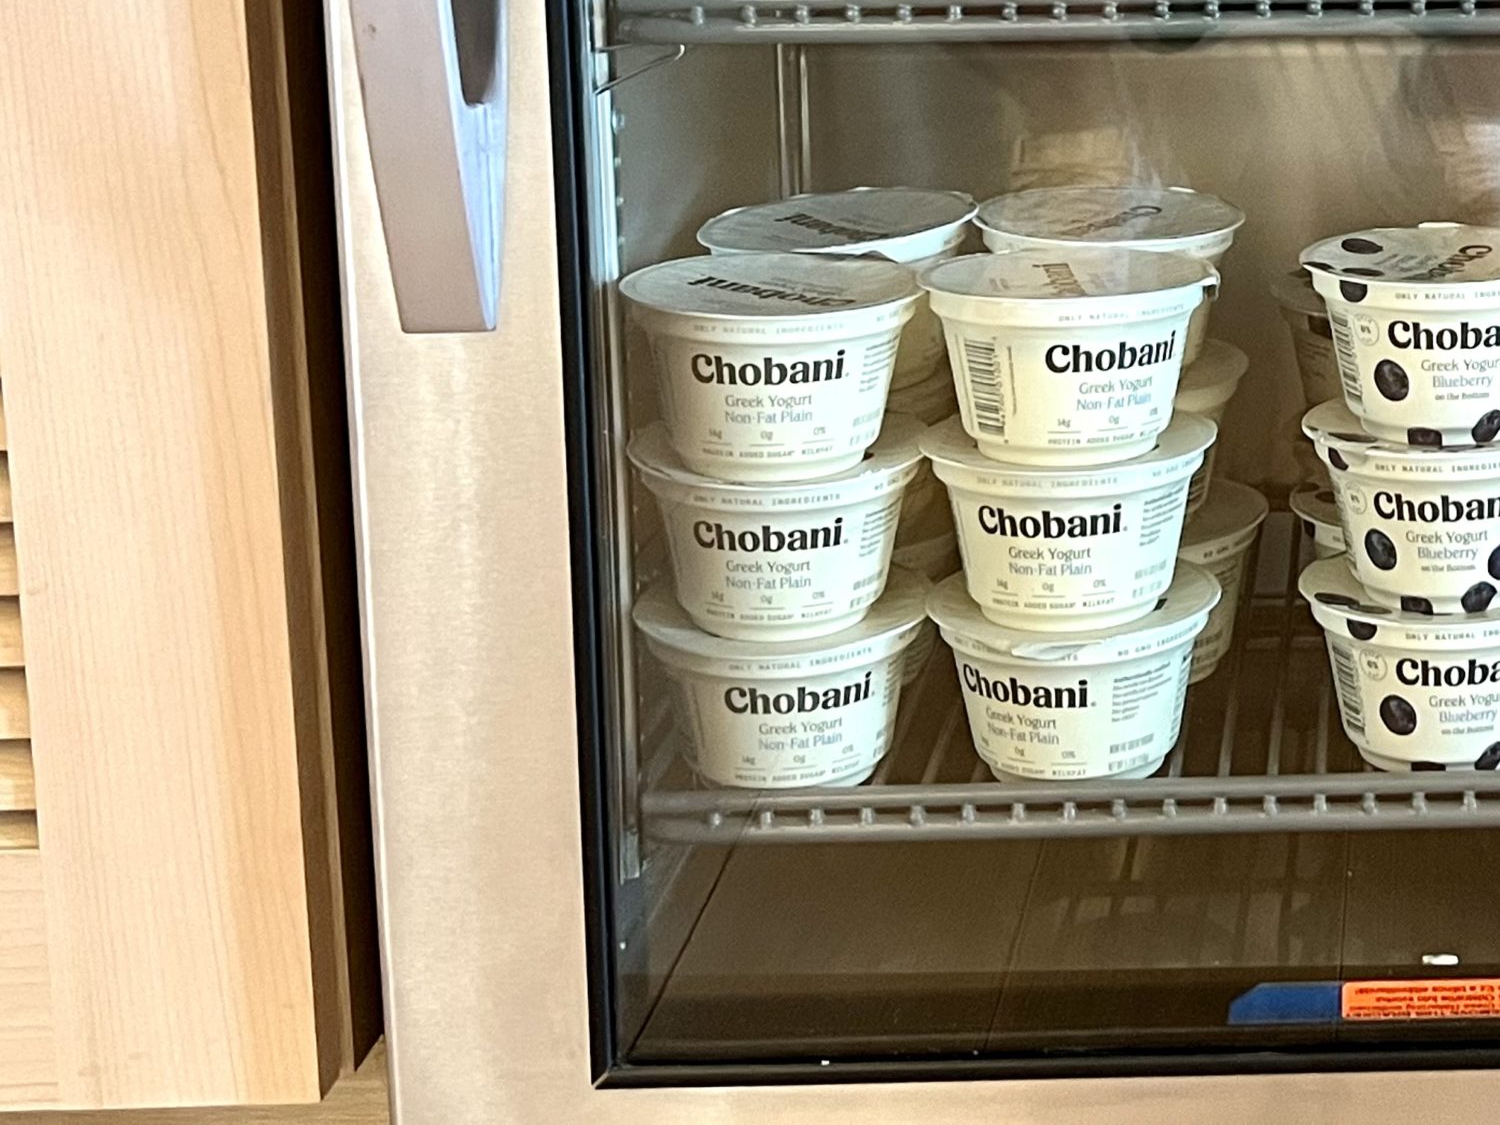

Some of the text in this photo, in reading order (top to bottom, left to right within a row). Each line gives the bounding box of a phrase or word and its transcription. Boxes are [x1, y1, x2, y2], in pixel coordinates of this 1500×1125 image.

[1045, 330, 1176, 373] Chobani
[692, 349, 845, 386] Chobani
[1421, 360, 1459, 371] Greek
[1079, 377, 1153, 393] Greek Yogurt
[1432, 375, 1493, 388] Blueberry
[726, 395, 812, 408] Greek Yogurt
[1077, 393, 1151, 411] Non-Fat Plain
[726, 411, 812, 423] Non-Fat Plain
[978, 504, 1122, 539] Chobani
[693, 517, 843, 552] Chobani
[1406, 530, 1488, 543] Greek Yogurt
[1009, 547, 1091, 563] Greek Yogurt
[1418, 547, 1478, 560] Blueberry
[727, 560, 810, 574] Greek Yogurt
[1009, 563, 1092, 575] Non-Fat Plain
[727, 576, 811, 589] Non-Fat Plain
[725, 672, 872, 714] Chobani
[963, 663, 1088, 709] Chobani
[1429, 695, 1466, 707] Greek
[986, 707, 1056, 730] Greek Yogurt
[1439, 709, 1498, 724] Blueberry
[759, 717, 842, 735] Greek Yogurt
[759, 732, 842, 750] Non-Fat Plain
[1030, 730, 1059, 745] Plain
